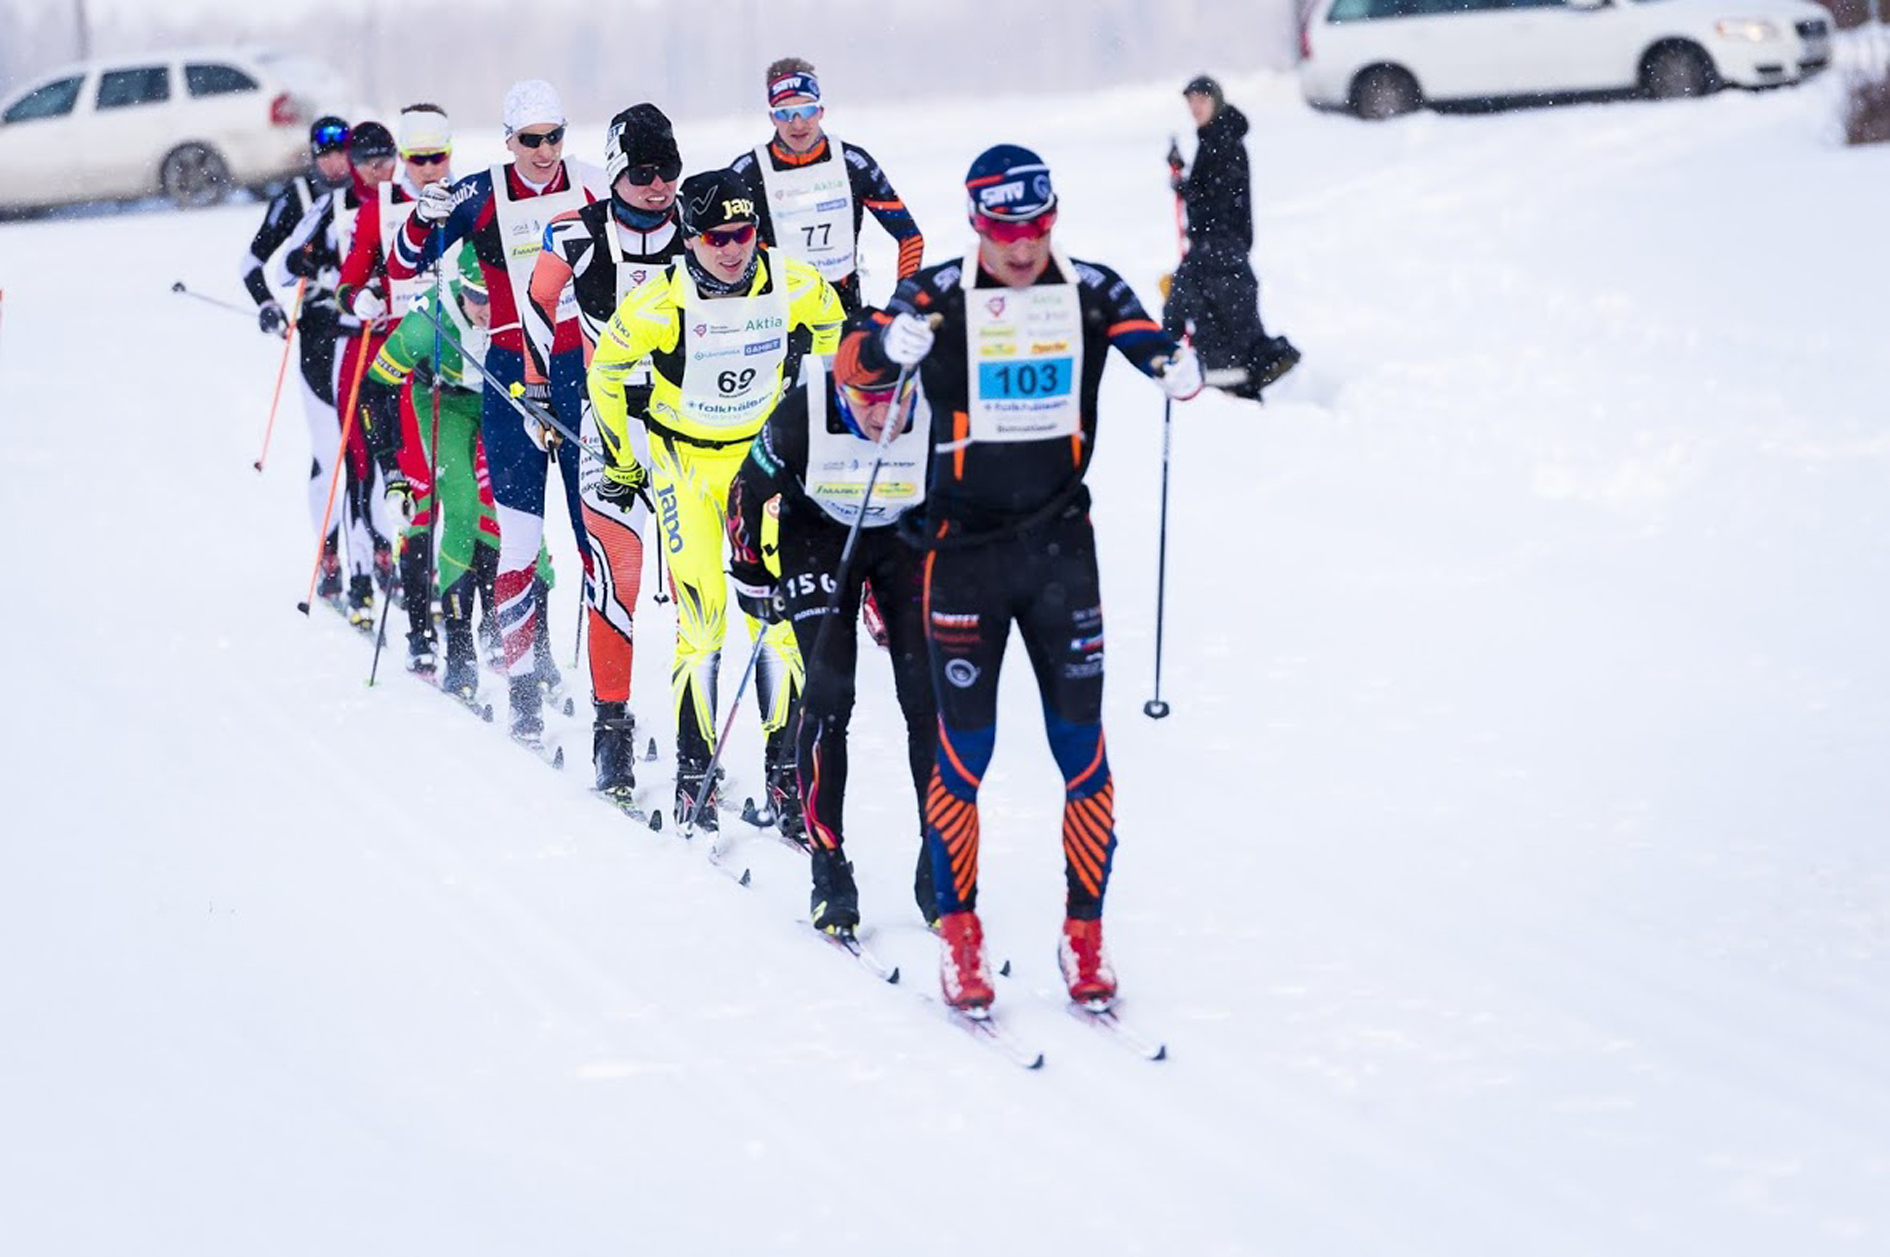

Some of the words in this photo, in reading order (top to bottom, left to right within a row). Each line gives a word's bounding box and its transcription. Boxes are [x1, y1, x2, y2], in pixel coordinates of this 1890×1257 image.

[801, 223, 831, 247] 77
[745, 317, 783, 332] Aktia
[717, 368, 757, 394] 69
[995, 364, 1058, 395] 103
